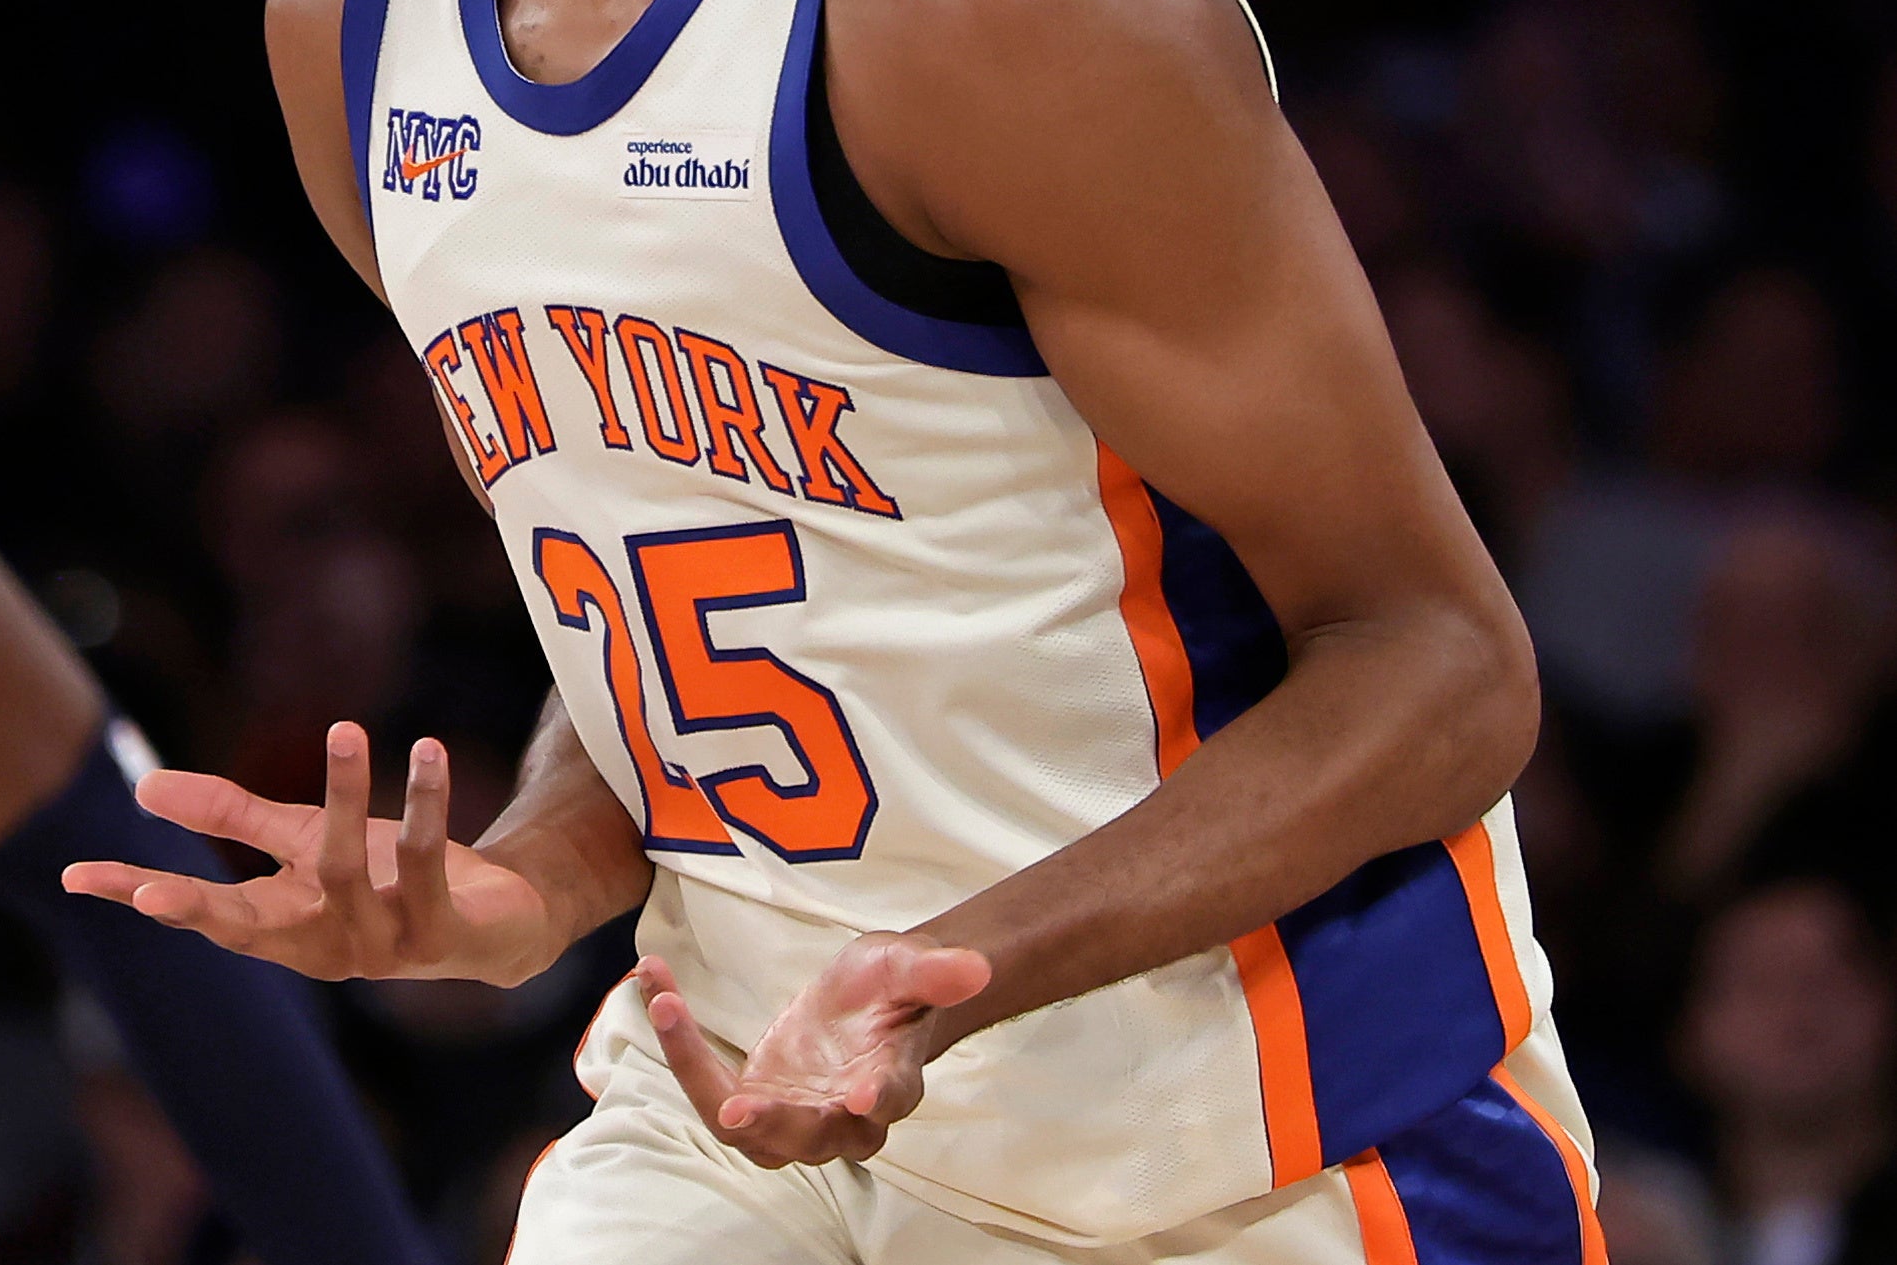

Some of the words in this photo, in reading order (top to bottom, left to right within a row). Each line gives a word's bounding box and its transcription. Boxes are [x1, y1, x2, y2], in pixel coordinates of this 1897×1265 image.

[383, 107, 481, 201] NYC
[623, 157, 670, 187] abu
[675, 157, 750, 189] dhabi
[626, 138, 693, 156] experience
[420, 307, 557, 490] EW
[544, 304, 903, 520] YORK
[532, 519, 879, 864] 25
